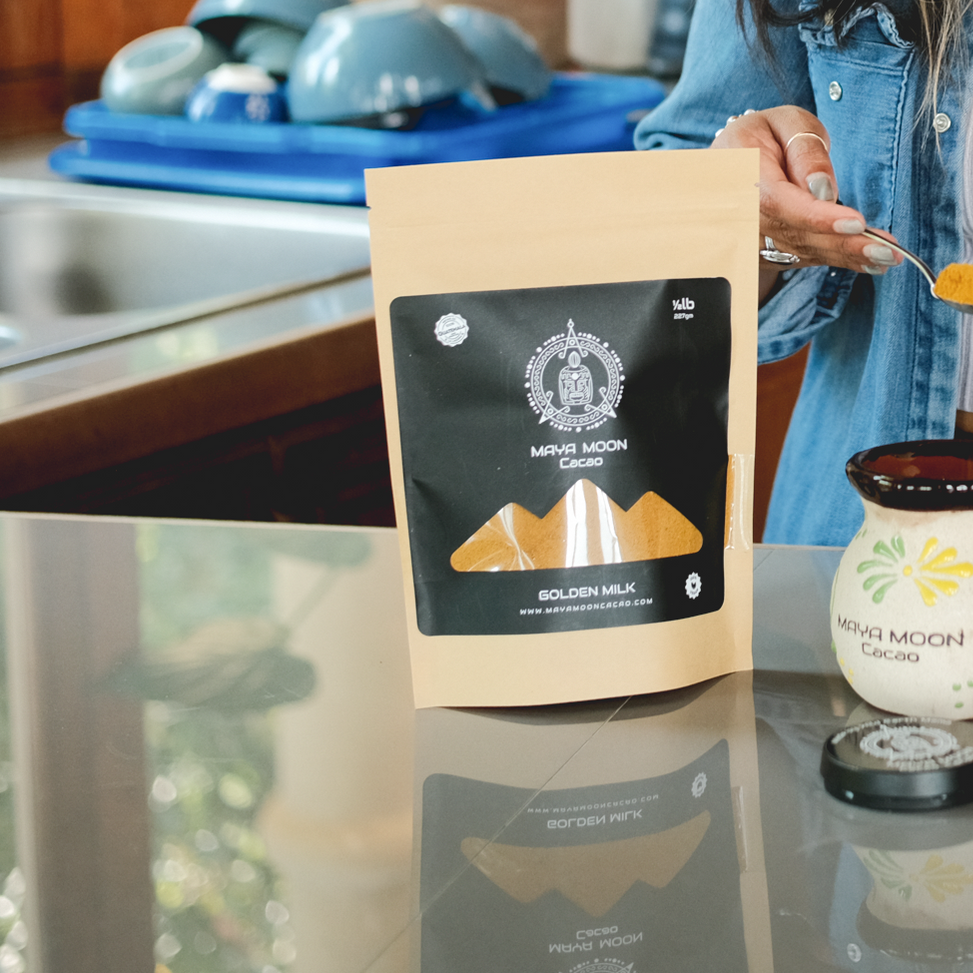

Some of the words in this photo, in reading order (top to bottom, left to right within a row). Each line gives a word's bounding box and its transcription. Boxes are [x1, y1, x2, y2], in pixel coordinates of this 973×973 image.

[530, 443, 576, 457] MAYA
[582, 438, 628, 454] MOON
[559, 456, 604, 469] Cacao
[538, 586, 599, 601] GOLDEN
[602, 581, 636, 596] MILK
[519, 597, 654, 615] WWW.MAYAMOONCACAO.COM
[837, 614, 882, 642] MAYA
[889, 628, 964, 647] MOON
[861, 642, 920, 663] Cacao
